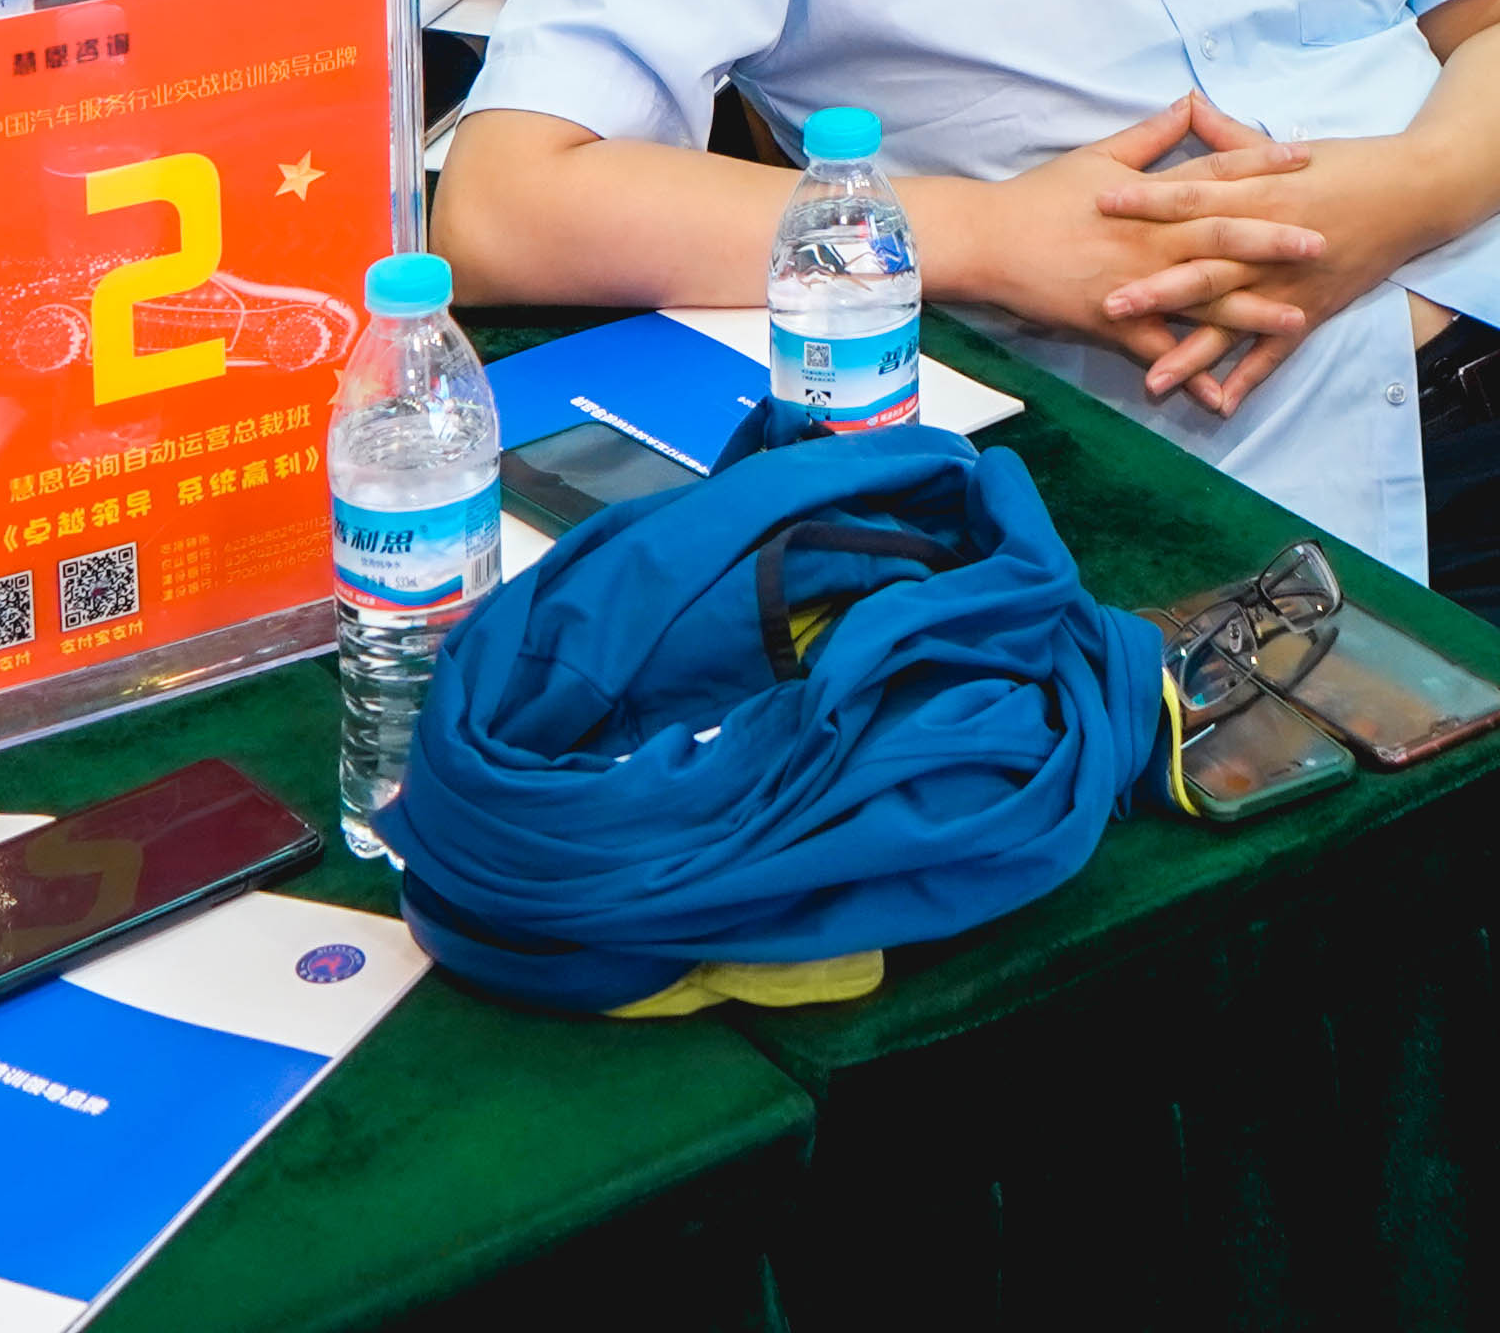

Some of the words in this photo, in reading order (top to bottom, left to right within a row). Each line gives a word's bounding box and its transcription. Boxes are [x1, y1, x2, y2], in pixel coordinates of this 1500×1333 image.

[85, 151, 227, 408] 2
[9, 403, 312, 504] 慧恩咨询自动运营总裁班
